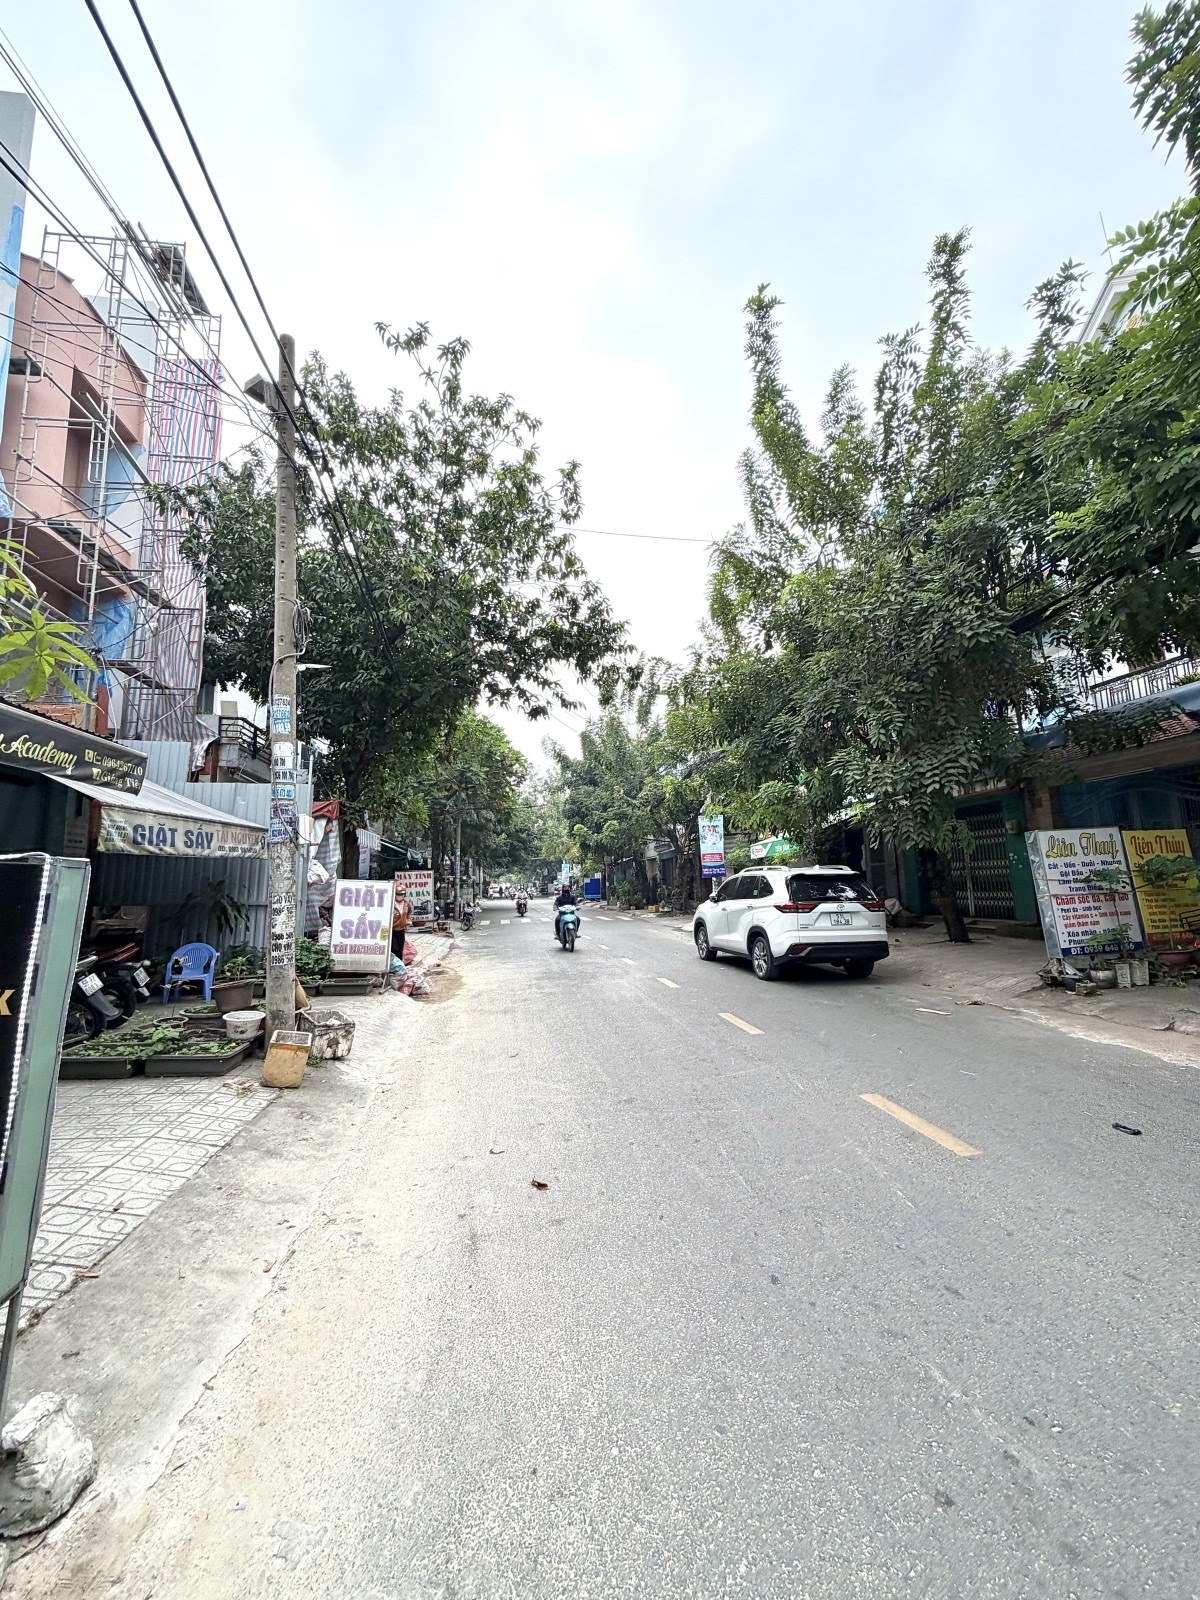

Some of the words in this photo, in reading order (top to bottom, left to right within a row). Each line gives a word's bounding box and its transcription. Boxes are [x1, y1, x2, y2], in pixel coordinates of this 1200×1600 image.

[1, 734, 77, 775] Academy
[184, 824, 214, 850] SẤY
[1046, 834, 1078, 858] Liên
[1130, 835, 1155, 860] Liên
[339, 912, 382, 940] SẤY
